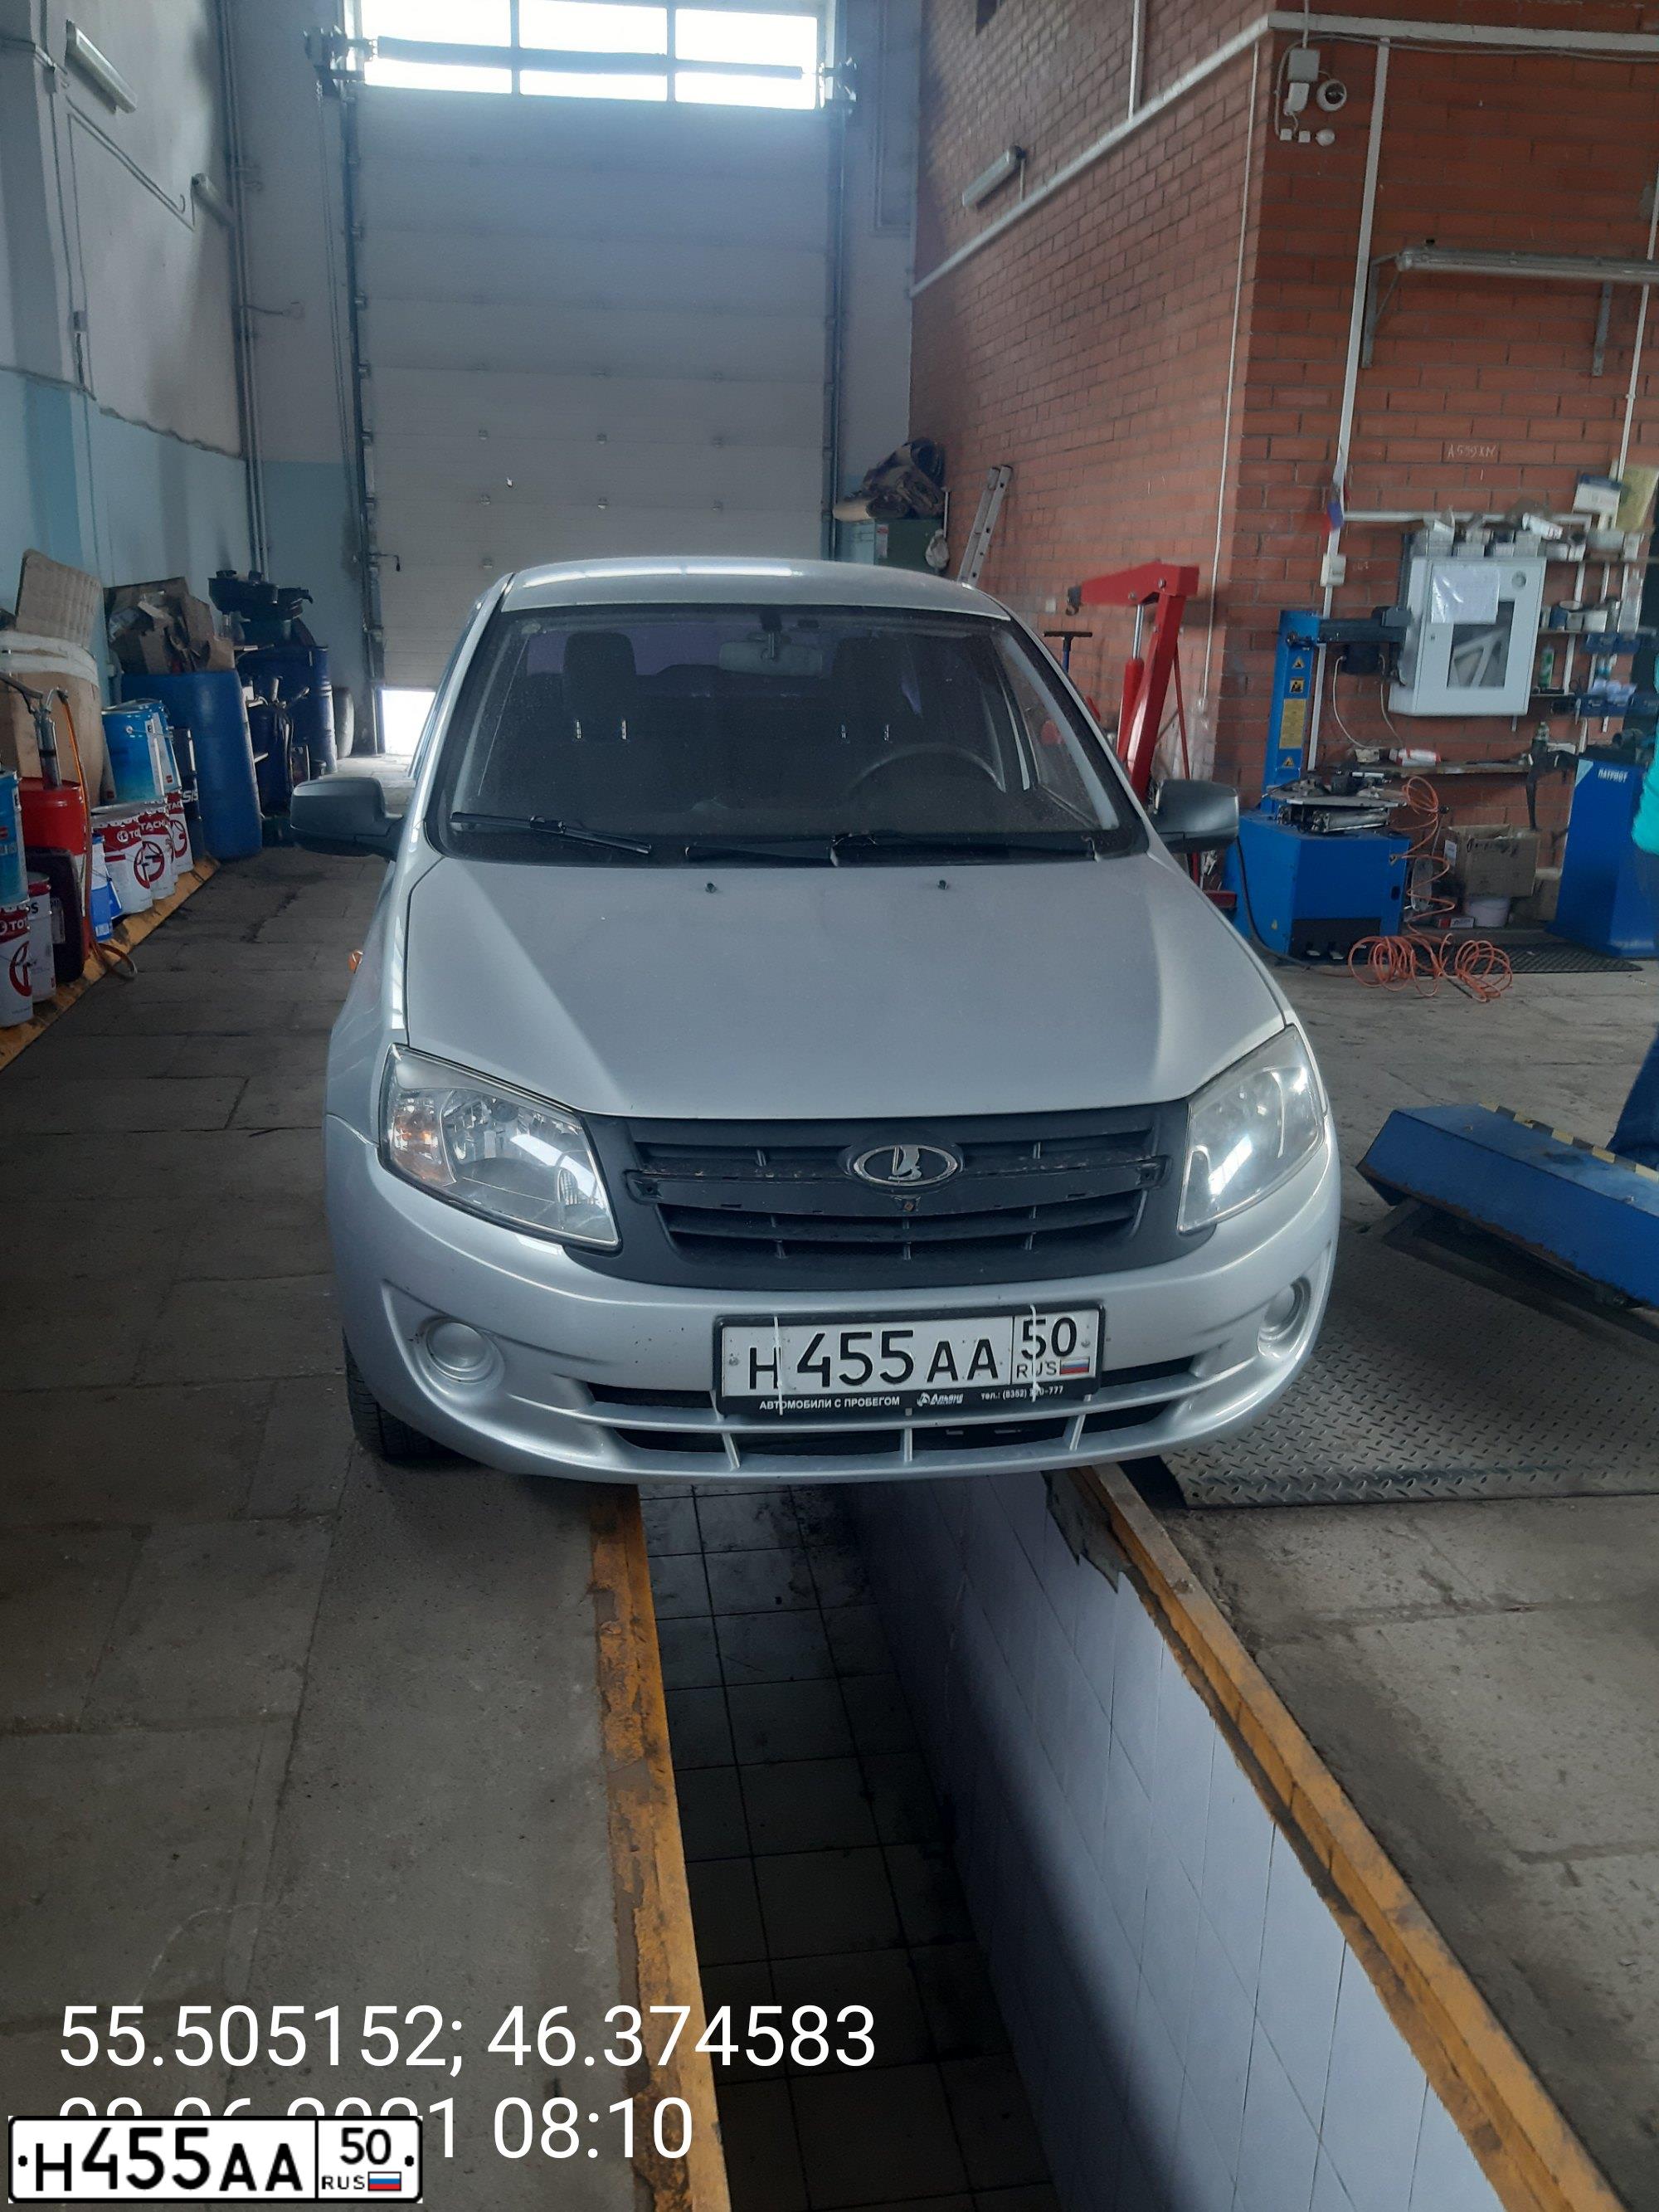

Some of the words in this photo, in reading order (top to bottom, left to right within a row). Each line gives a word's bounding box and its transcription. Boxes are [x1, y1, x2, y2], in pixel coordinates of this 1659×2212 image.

[1021, 1318, 1077, 1360] 50
[1016, 1361, 1057, 1379] RUS
[759, 1398, 831, 1410] АВТОМОБИЛИ
[834, 1399, 841, 1408] С
[844, 1396, 900, 1407] ПРОБЕГОМ
